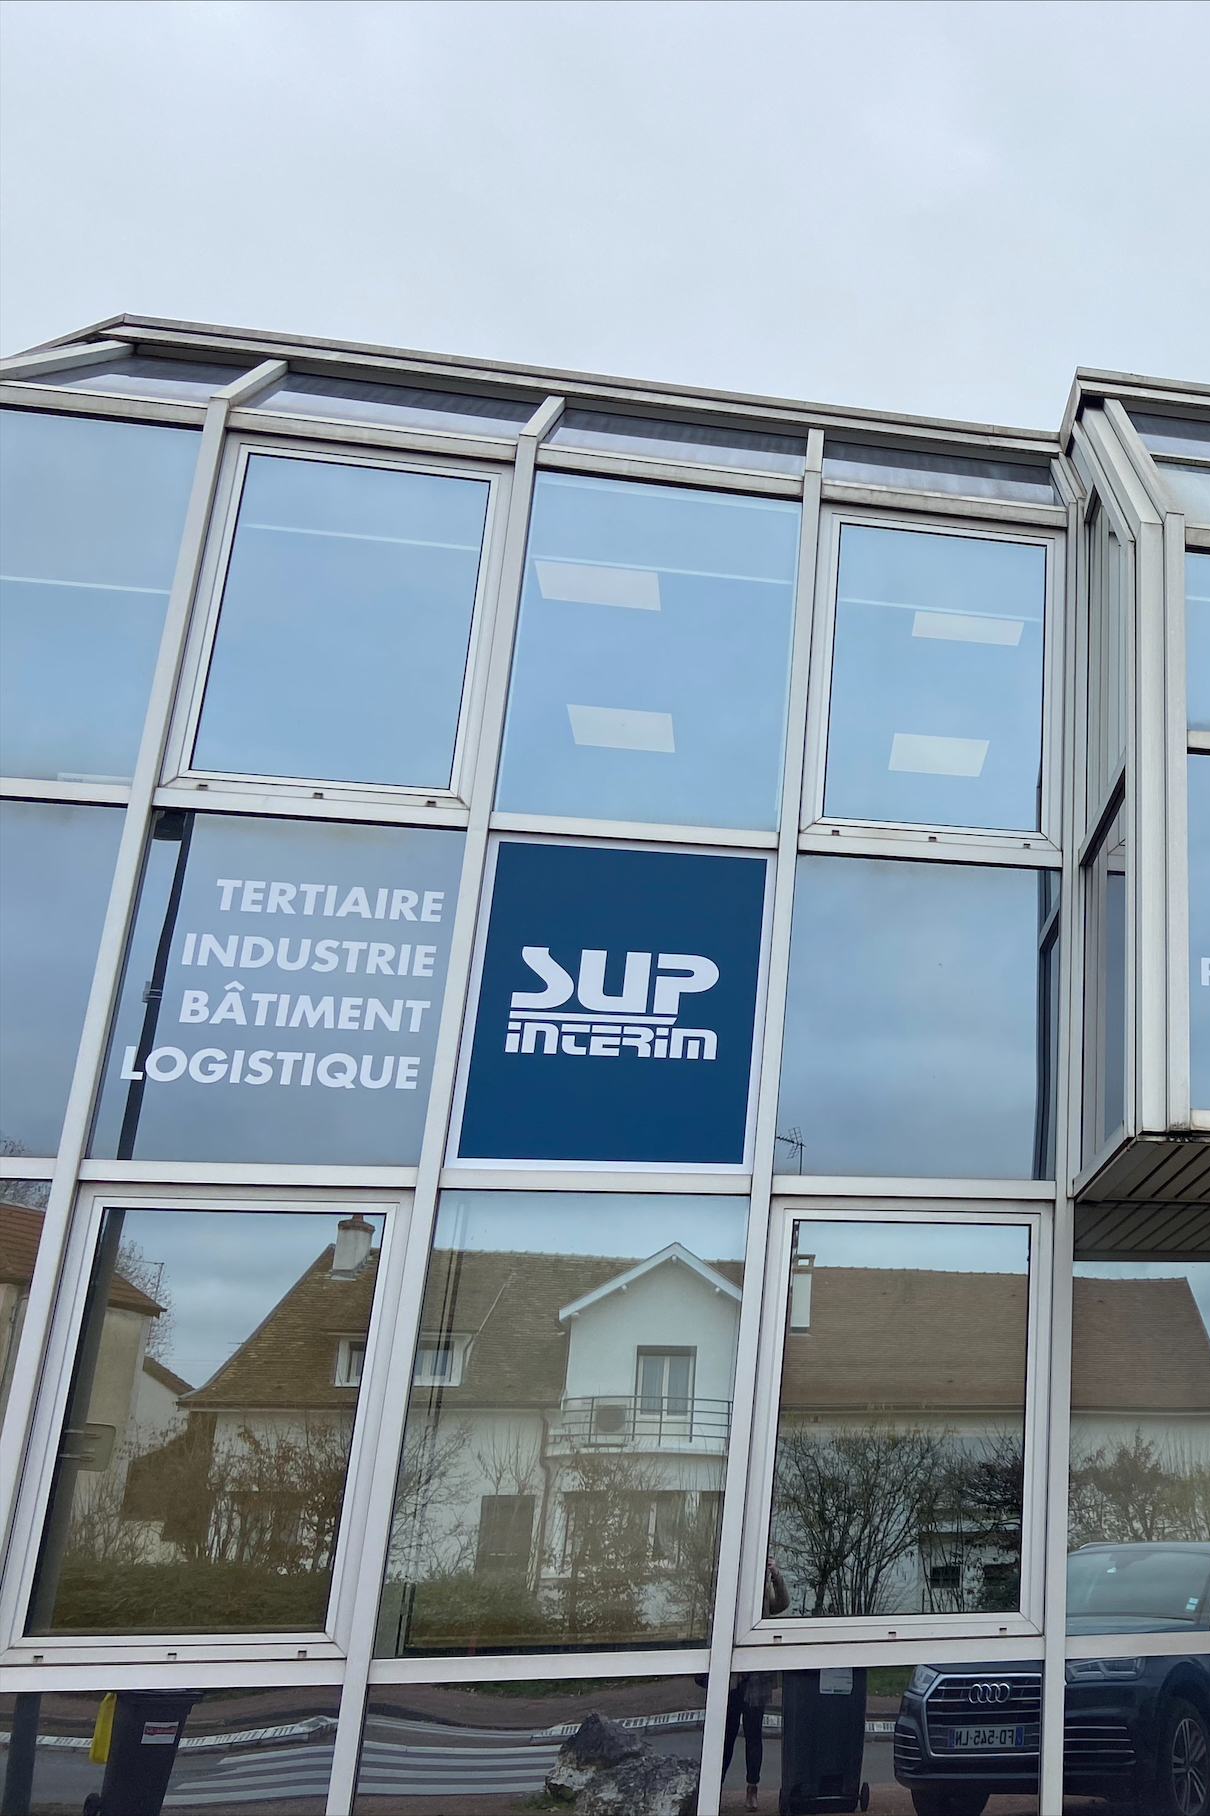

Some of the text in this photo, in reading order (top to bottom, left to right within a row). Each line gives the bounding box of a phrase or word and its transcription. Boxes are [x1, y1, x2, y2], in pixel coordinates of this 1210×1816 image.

[216, 878, 445, 923] TERTIAIRE
[181, 932, 437, 978] INDUSTRIE
[510, 946, 720, 1015] SUP
[179, 980, 431, 1033] BÂTIMENT
[120, 1045, 420, 1090] LOGISTIQUE
